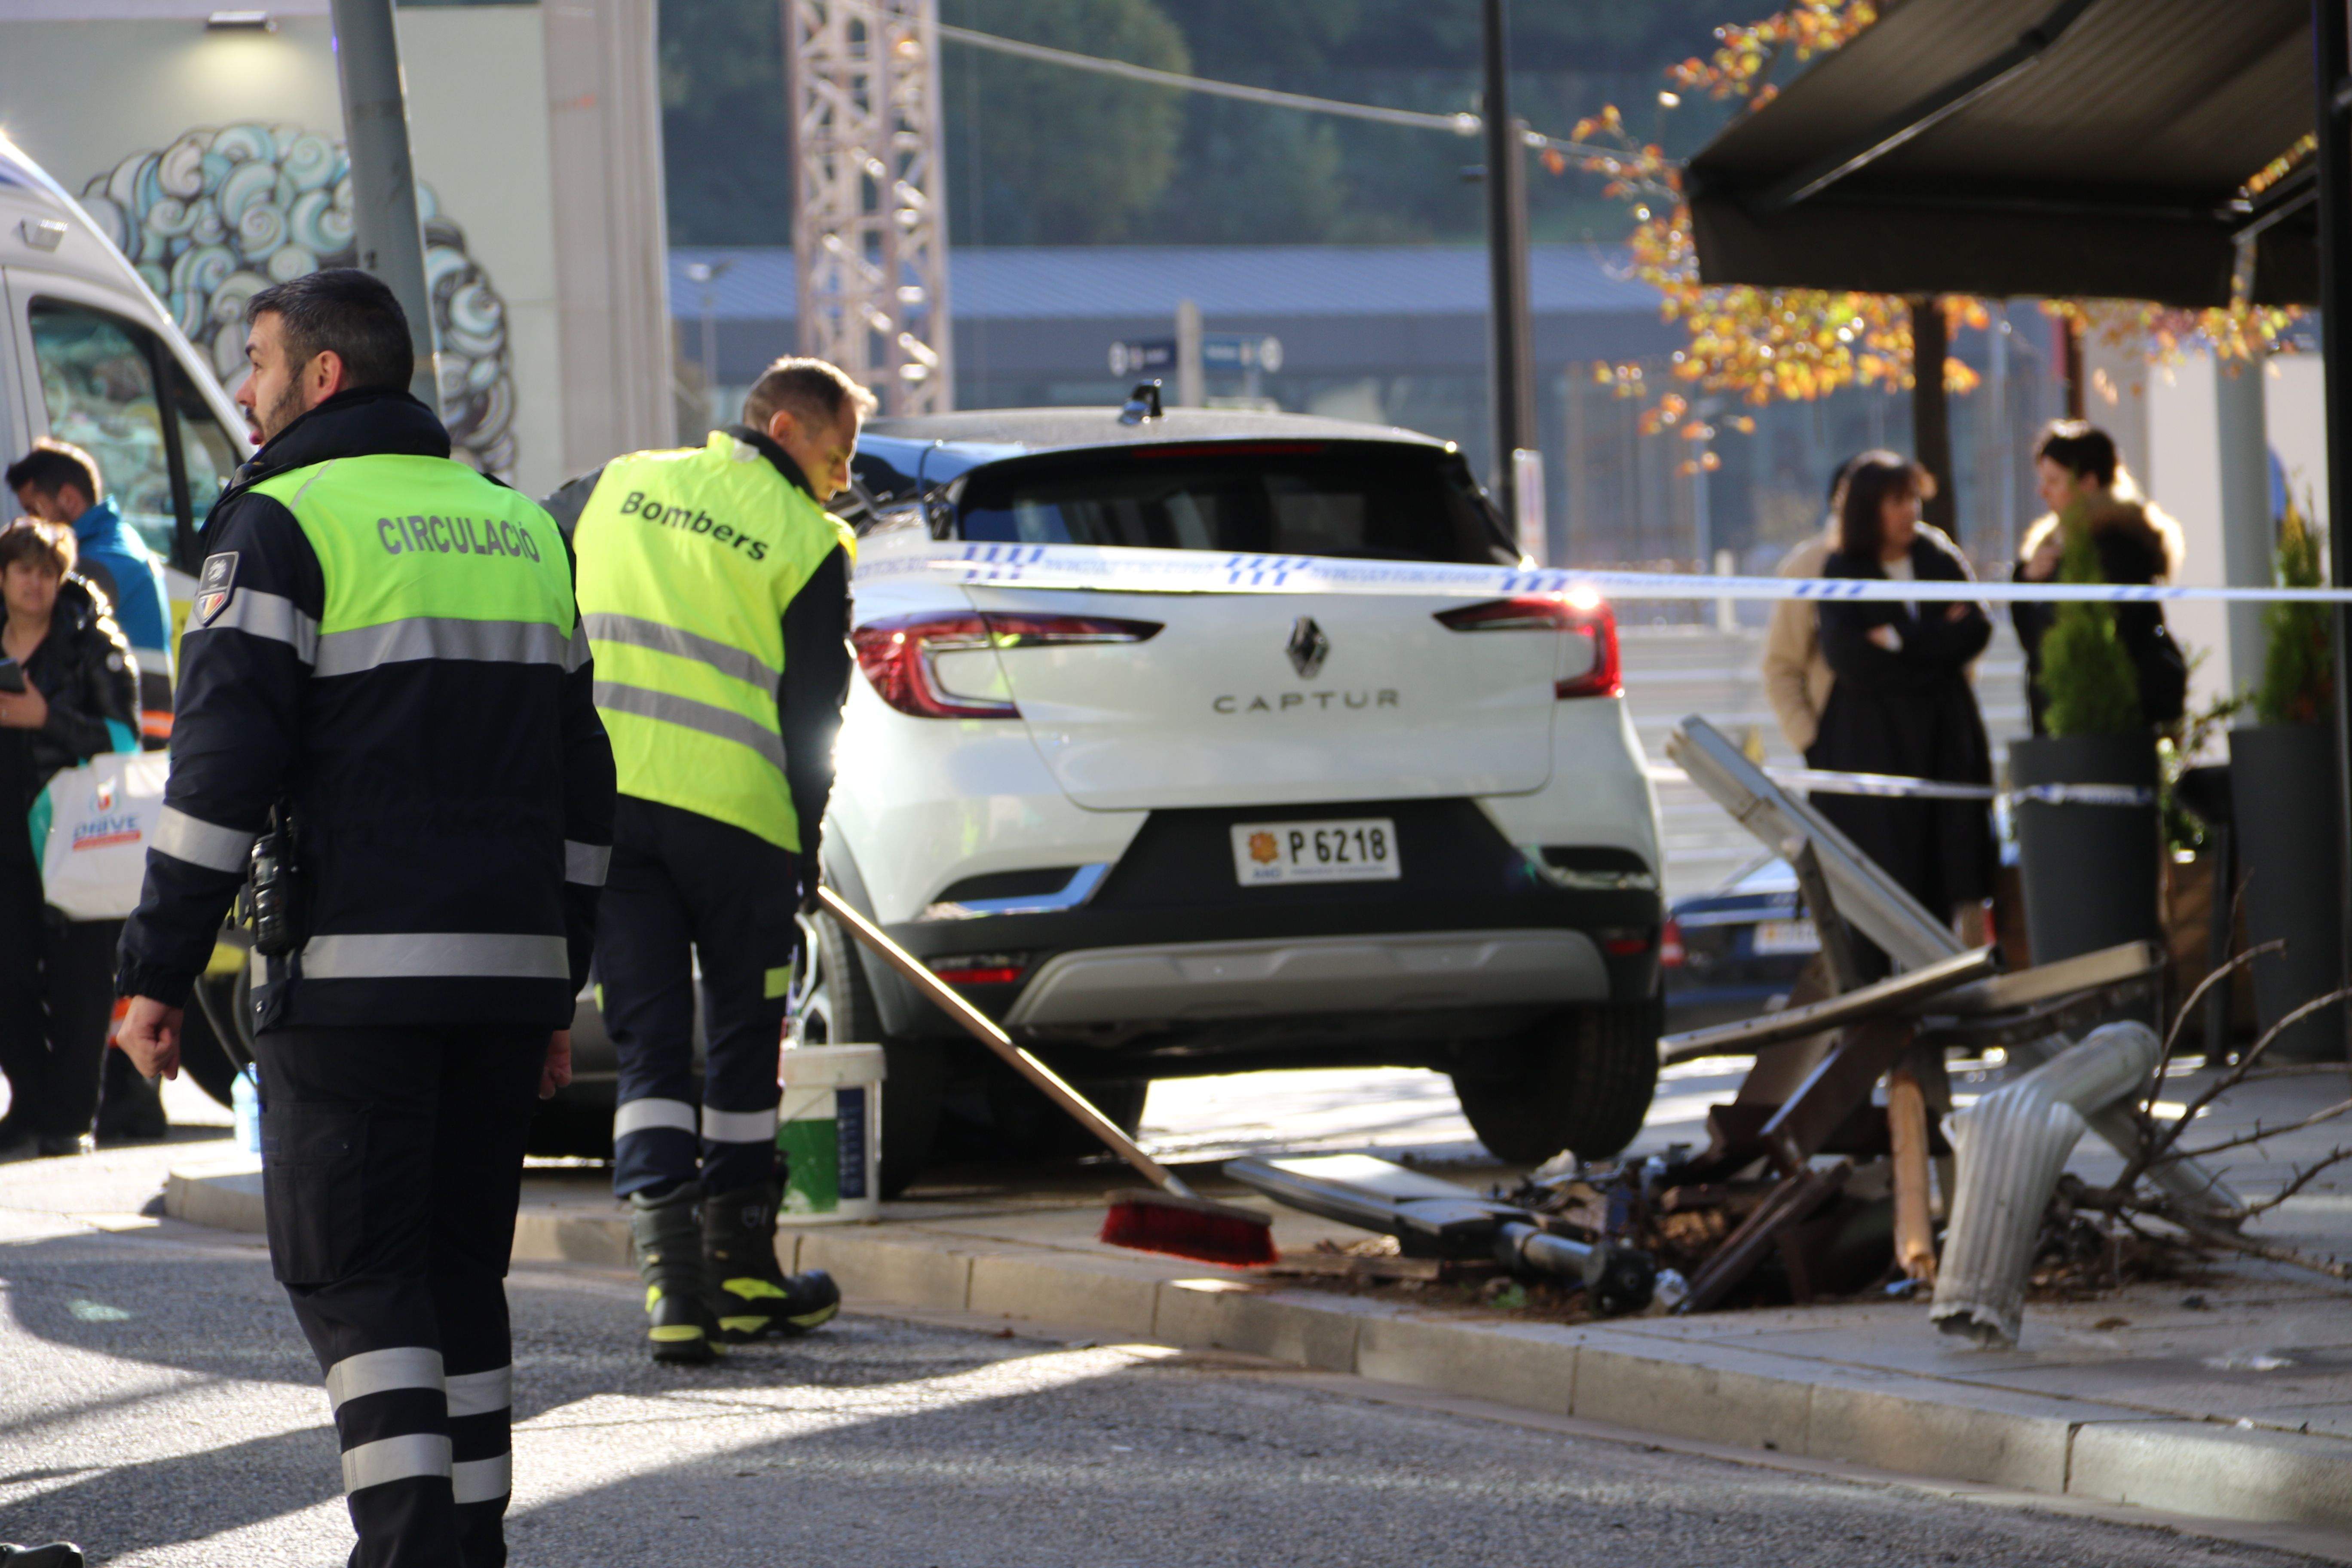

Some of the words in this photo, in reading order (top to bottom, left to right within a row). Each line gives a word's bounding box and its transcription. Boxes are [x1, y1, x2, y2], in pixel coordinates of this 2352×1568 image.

[377, 515, 540, 563] CIRCULACIÓ
[620, 491, 769, 561] Bombers
[1212, 689, 1400, 714] CAPTUR
[1288, 830, 1305, 864] P
[1314, 827, 1387, 863] 6218
